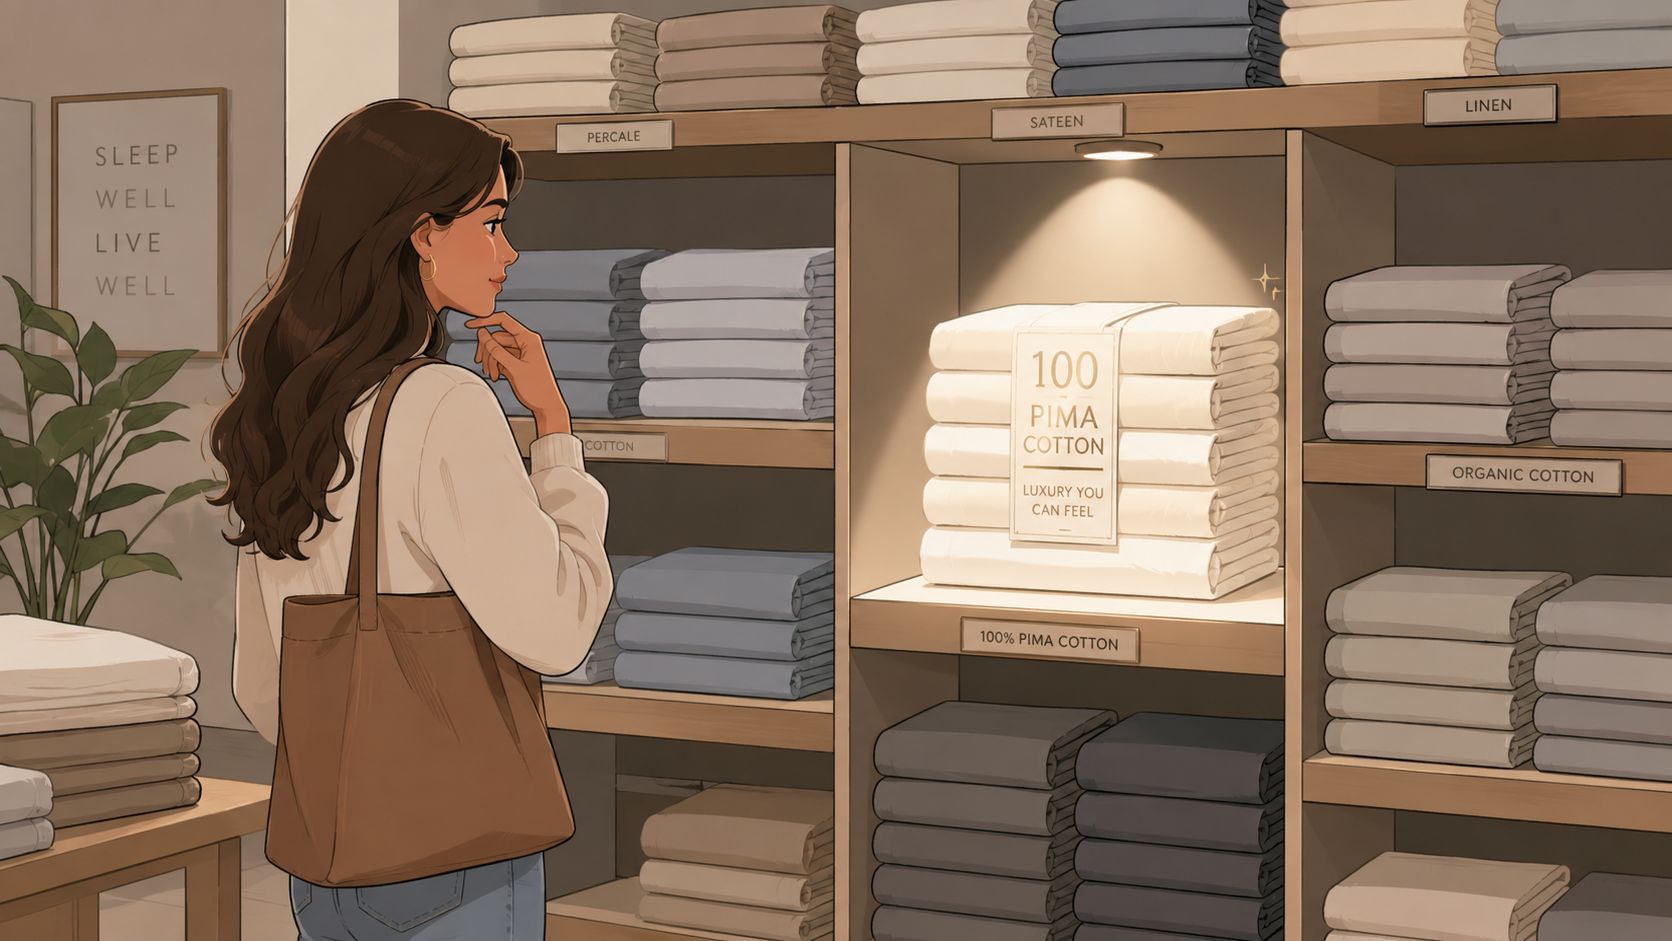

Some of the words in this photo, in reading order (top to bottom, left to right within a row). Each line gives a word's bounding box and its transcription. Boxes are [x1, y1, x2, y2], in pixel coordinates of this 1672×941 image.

[1465, 98, 1512, 112] LINEN
[1030, 114, 1084, 129] SATEEN
[587, 129, 641, 144] PERCALE
[95, 143, 178, 167] SLEEP
[95, 187, 176, 209] WELL
[96, 232, 161, 253] LIVE
[95, 275, 176, 297] WELL
[1032, 350, 1099, 390] 100
[1031, 404, 1099, 429] PIMA
[584, 440, 634, 452] COTTON
[1023, 435, 1104, 456] COTTON
[1452, 466, 1524, 482] ORGANIC
[1528, 468, 1594, 484] COTTON
[1023, 484, 1073, 498] LUXURY
[1076, 486, 1104, 500] YOU
[1031, 503, 1060, 517] CAN
[1064, 505, 1094, 518] FEEL
[980, 630, 1015, 645] 100%
[1018, 632, 1054, 647] PIMA
[1058, 635, 1119, 651] COTTON
